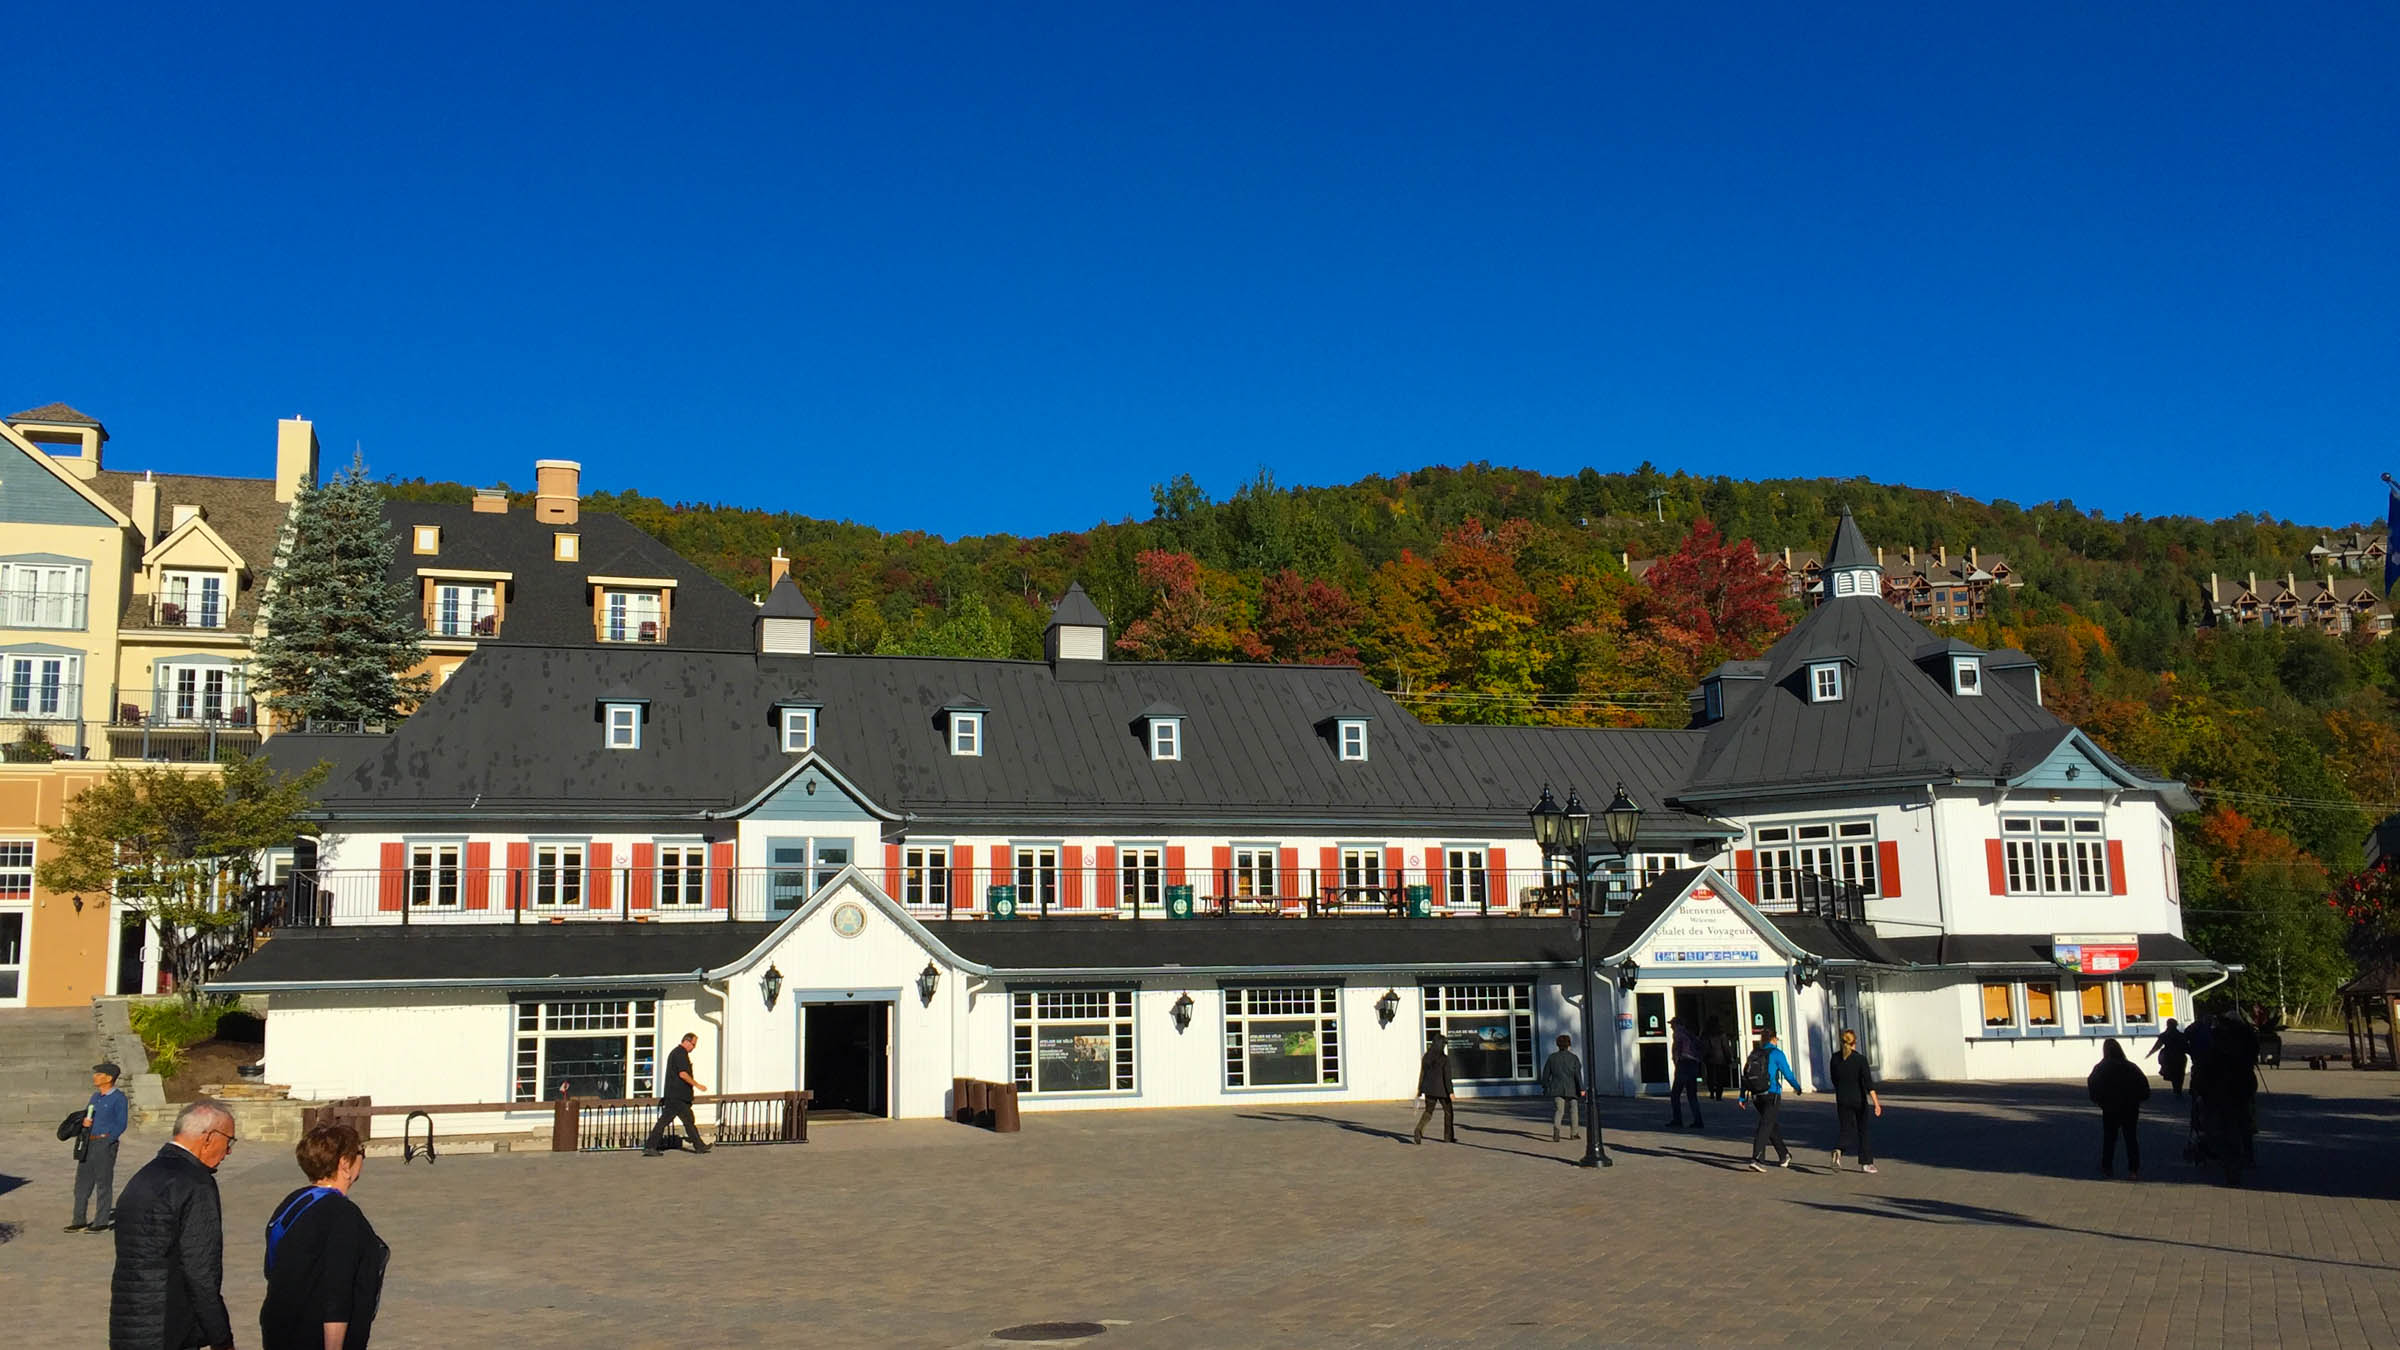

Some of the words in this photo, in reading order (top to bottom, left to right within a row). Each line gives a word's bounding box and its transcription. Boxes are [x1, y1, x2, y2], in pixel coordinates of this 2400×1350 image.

[1679, 906, 1727, 915] Bienvenue
[1655, 926, 1685, 936] Chalet
[1689, 926, 1704, 936] des
[1707, 926, 1754, 937] Voyageurs
